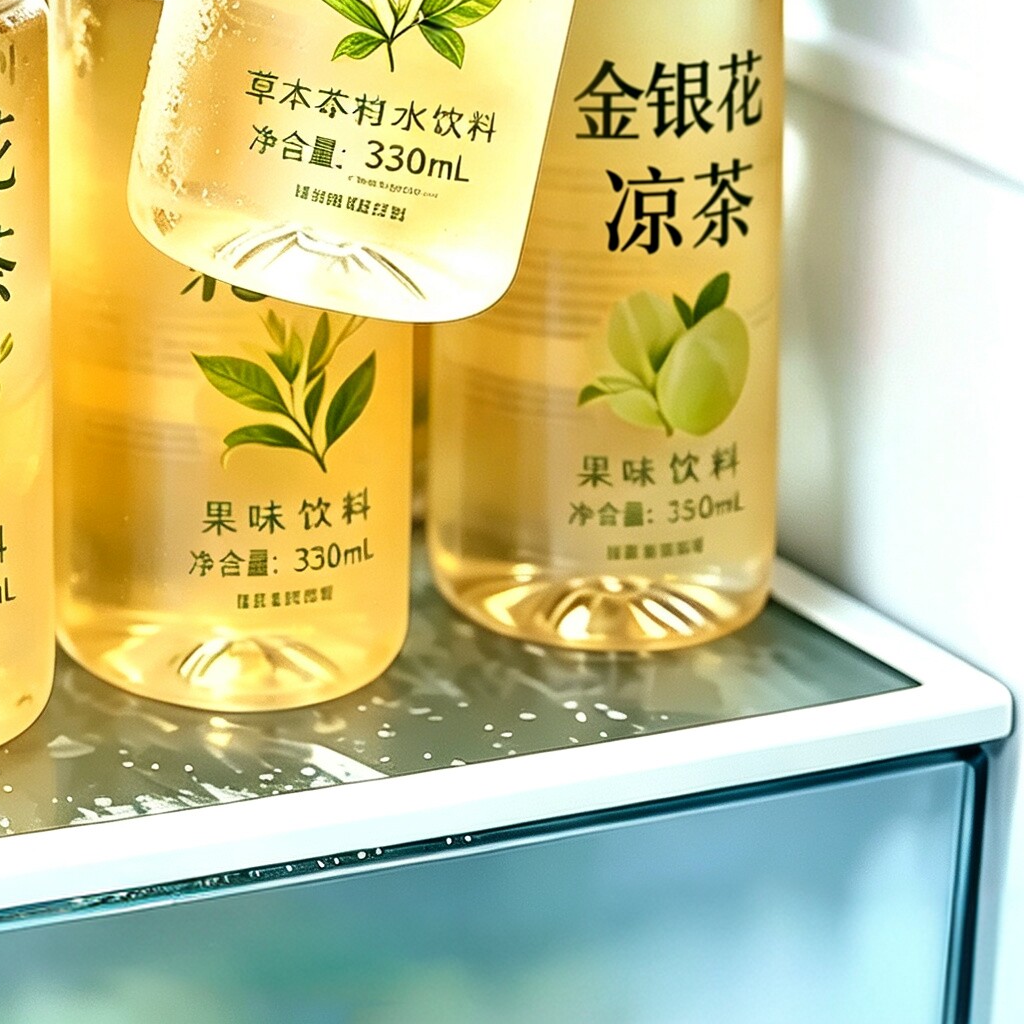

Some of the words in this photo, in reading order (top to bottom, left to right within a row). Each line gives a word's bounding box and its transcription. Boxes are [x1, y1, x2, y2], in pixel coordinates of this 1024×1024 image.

[574, 49, 763, 140] 金银花
[364, 140, 470, 182] 330mL
[604, 158, 755, 255] 凉茶
[202, 487, 371, 536] 果味饮料
[294, 538, 374, 572] 330mL
